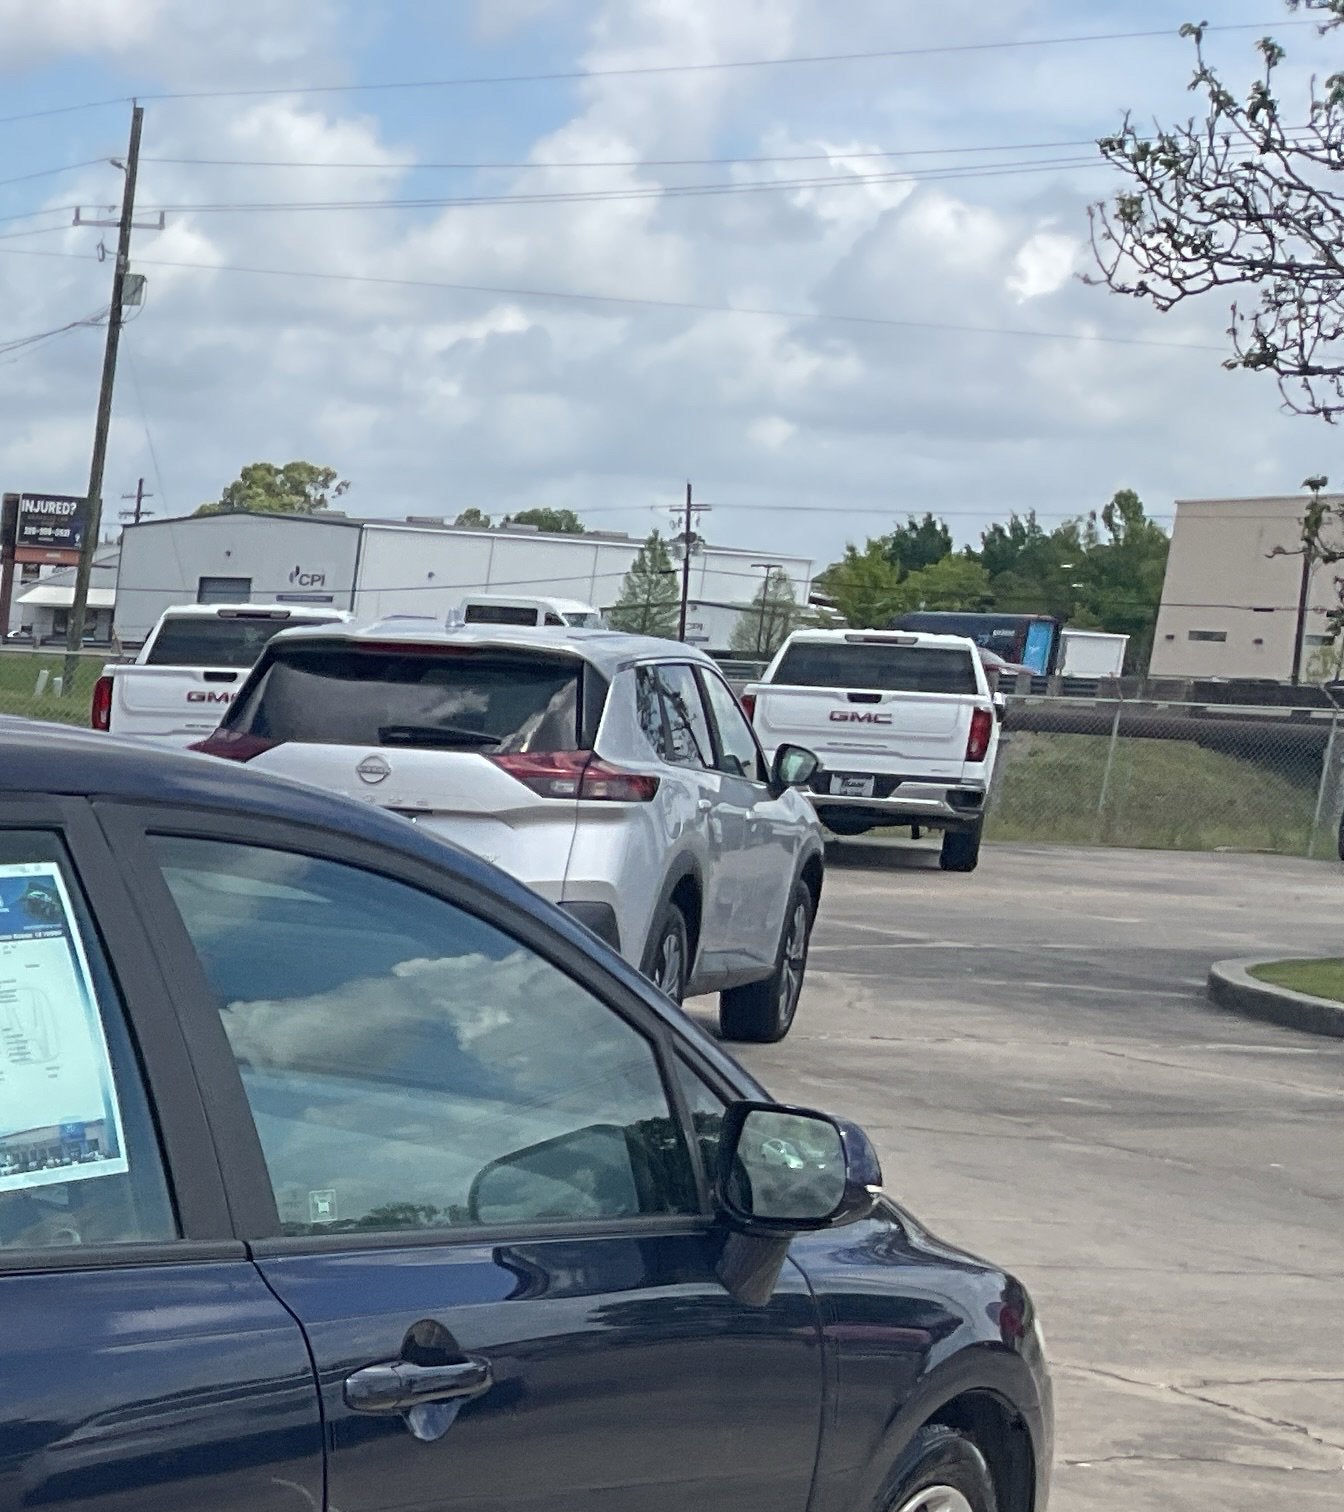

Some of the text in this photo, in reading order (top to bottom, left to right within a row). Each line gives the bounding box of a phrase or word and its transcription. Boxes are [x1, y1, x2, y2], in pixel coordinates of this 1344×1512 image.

[21, 499, 77, 516] INJURED?
[298, 573, 326, 587] CPI
[829, 710, 893, 724] GMC
